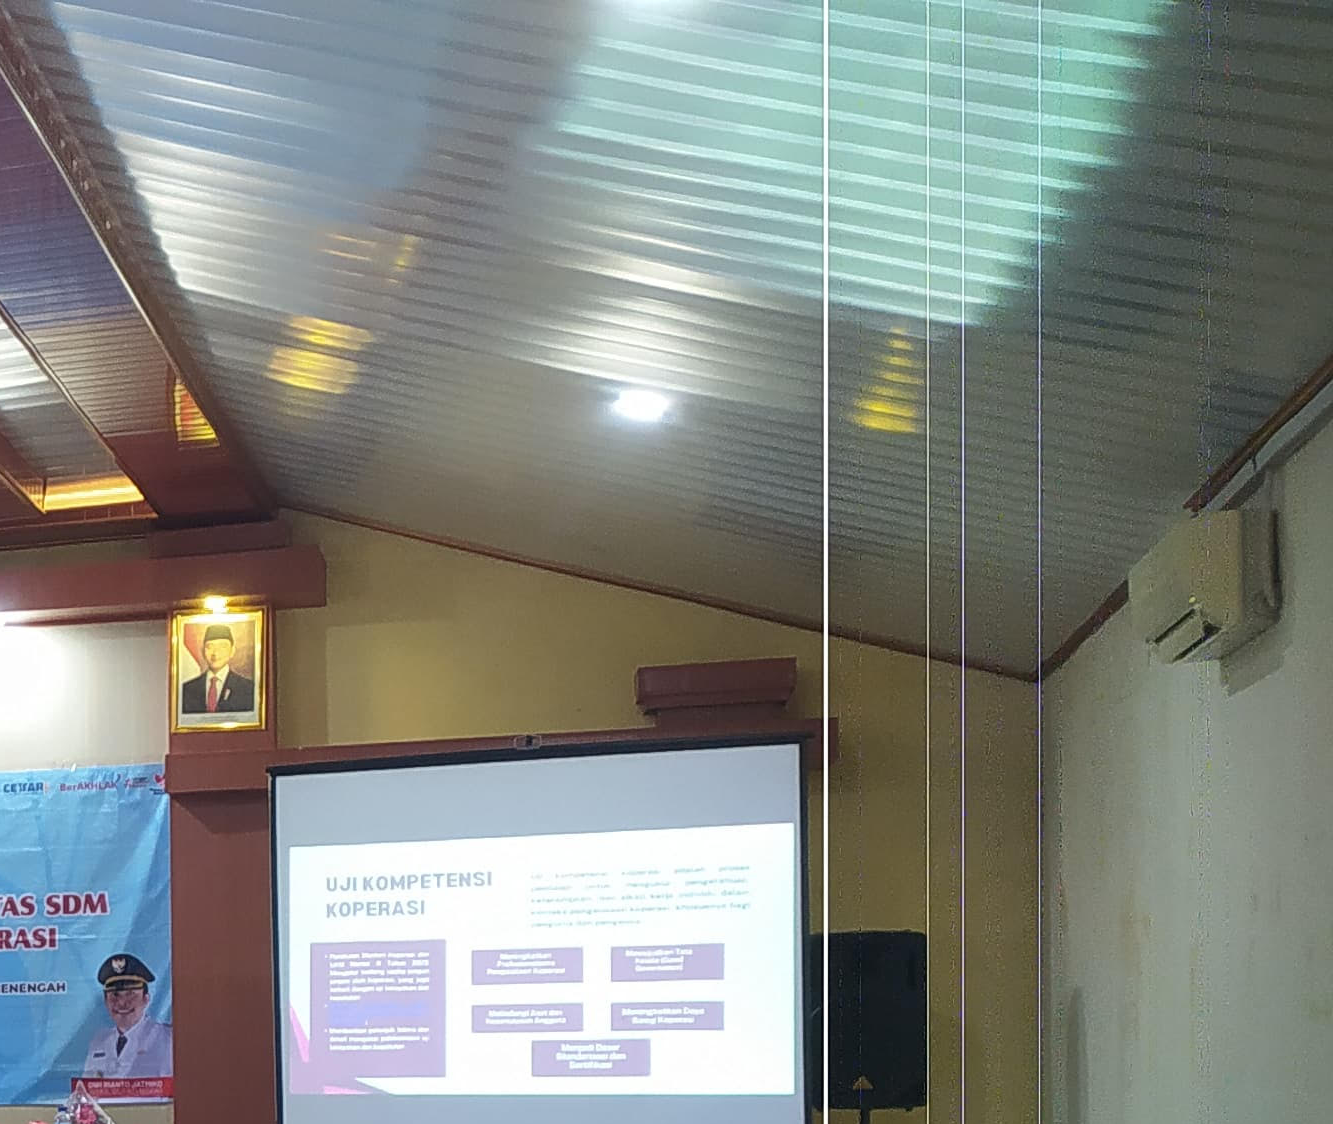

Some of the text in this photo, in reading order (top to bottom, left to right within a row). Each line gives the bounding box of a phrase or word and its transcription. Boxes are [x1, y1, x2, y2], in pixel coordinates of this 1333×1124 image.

[326, 871, 493, 892] UJI KOMPETENSI
[45, 892, 109, 916] SDM
[326, 899, 425, 919] KOPERASI
